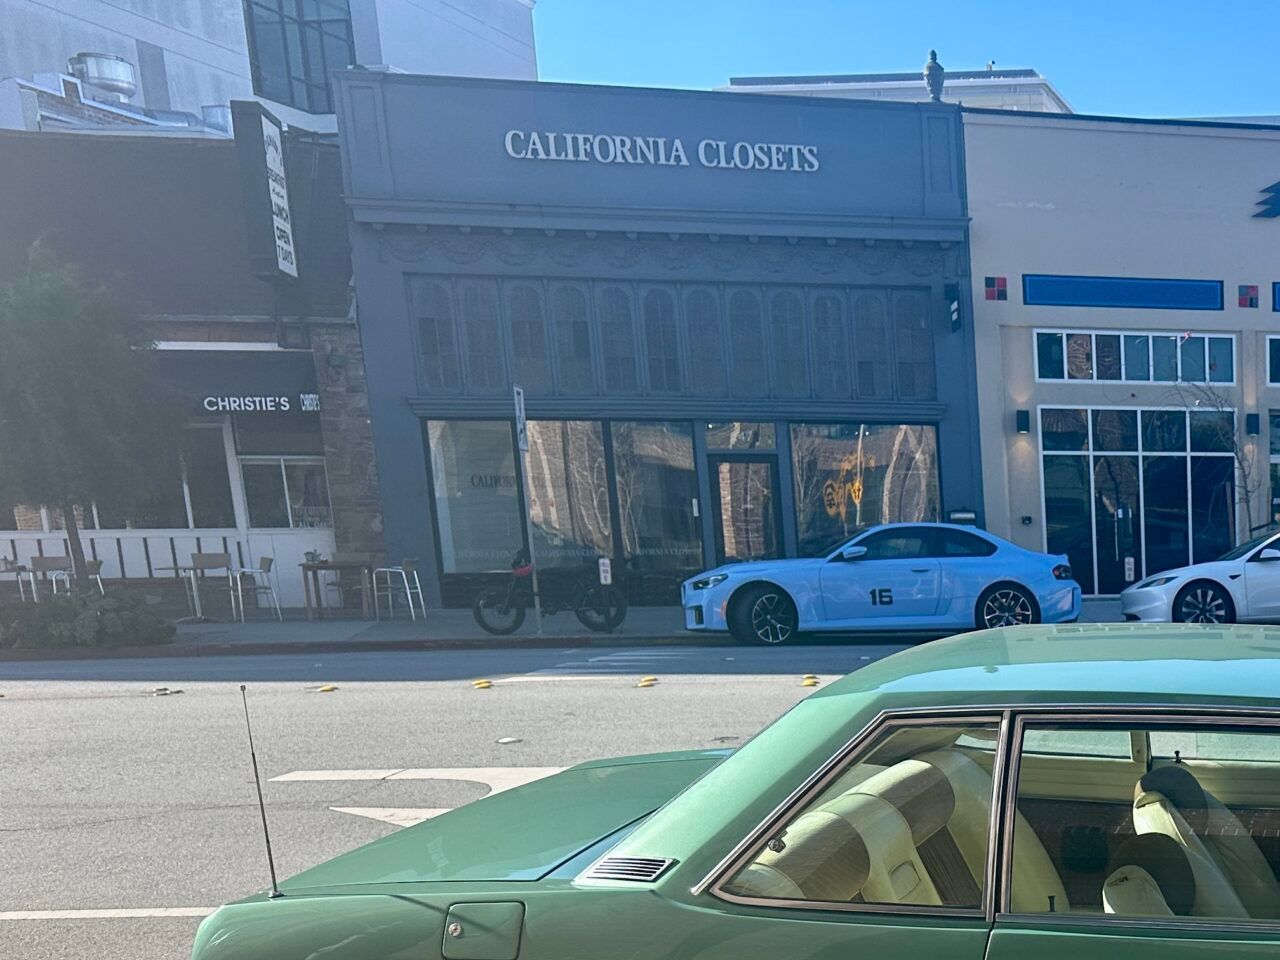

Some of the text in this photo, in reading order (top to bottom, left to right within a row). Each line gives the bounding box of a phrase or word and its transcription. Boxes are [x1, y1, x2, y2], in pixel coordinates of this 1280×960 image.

[504, 130, 819, 172] CALIFORNIA CLOSETS
[203, 396, 290, 411] CHRISTIE'S
[869, 588, 894, 606] 16
